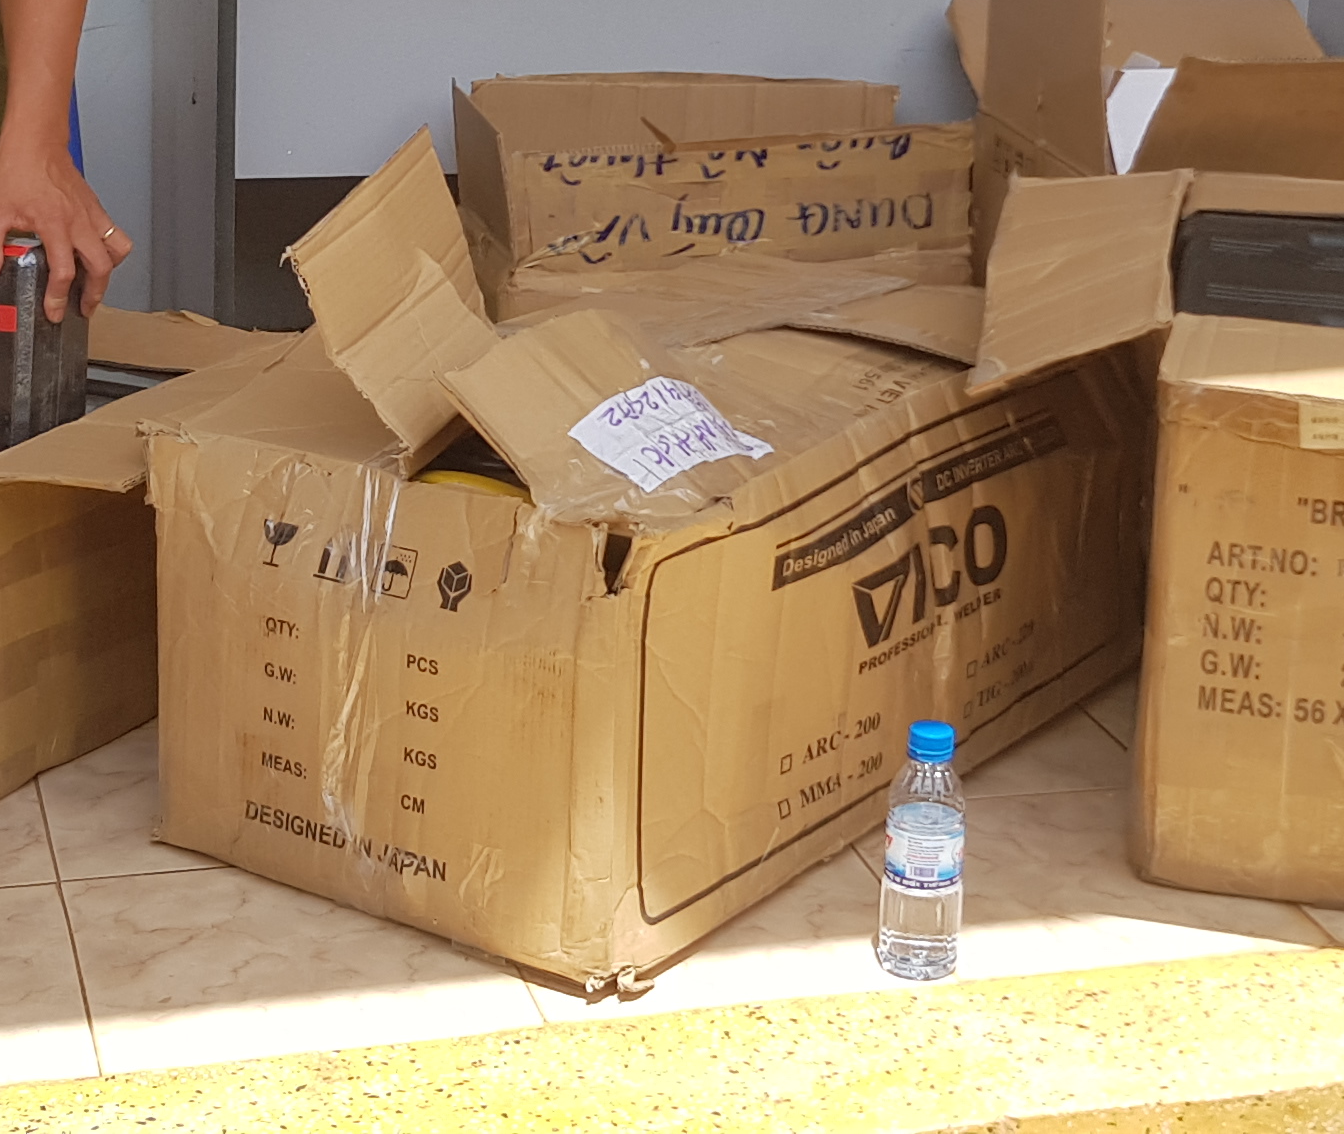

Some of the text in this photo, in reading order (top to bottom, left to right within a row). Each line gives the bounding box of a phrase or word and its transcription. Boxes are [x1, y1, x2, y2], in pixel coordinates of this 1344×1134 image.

[782, 506, 896, 577] Designed in Japan
[1205, 540, 1318, 577] ART.NO:
[1205, 576, 1268, 608] QTY:
[263, 617, 439, 676] QTY: PCS
[1201, 613, 1264, 645] N.W:
[264, 662, 440, 723] G.W: KGS
[1199, 648, 1262, 682] G.W:
[1197, 685, 1282, 719] MEAS:
[1293, 698, 1326, 725] 56
[262, 706, 438, 770] N.W: KGS
[260, 751, 426, 815] MEAS: CM
[244, 799, 347, 851] DESIGNED
[378, 843, 448, 882] JAPAN
